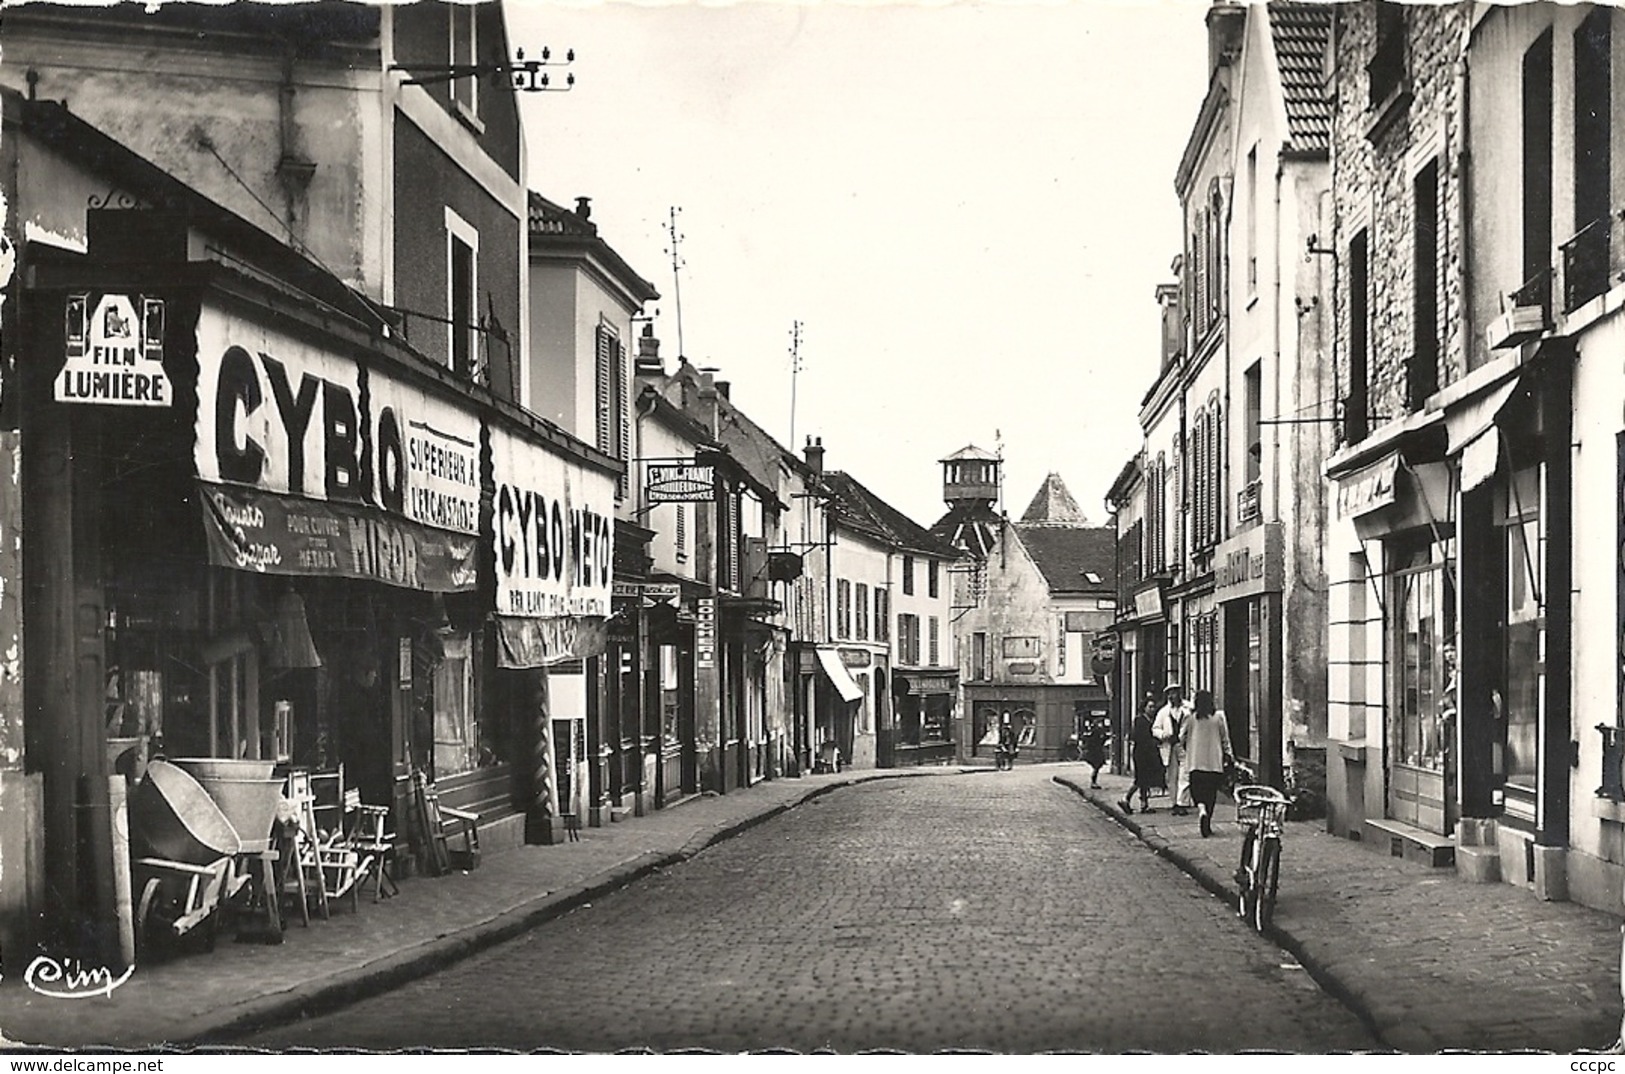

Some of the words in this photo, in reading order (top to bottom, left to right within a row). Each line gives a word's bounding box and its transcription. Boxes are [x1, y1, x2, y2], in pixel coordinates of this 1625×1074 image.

[64, 369, 163, 401] LUMIÈRE
[93, 346, 135, 366] FILM
[215, 345, 404, 512] CYBO
[346, 517, 419, 588] MIROR
[498, 484, 563, 582] CYBO
